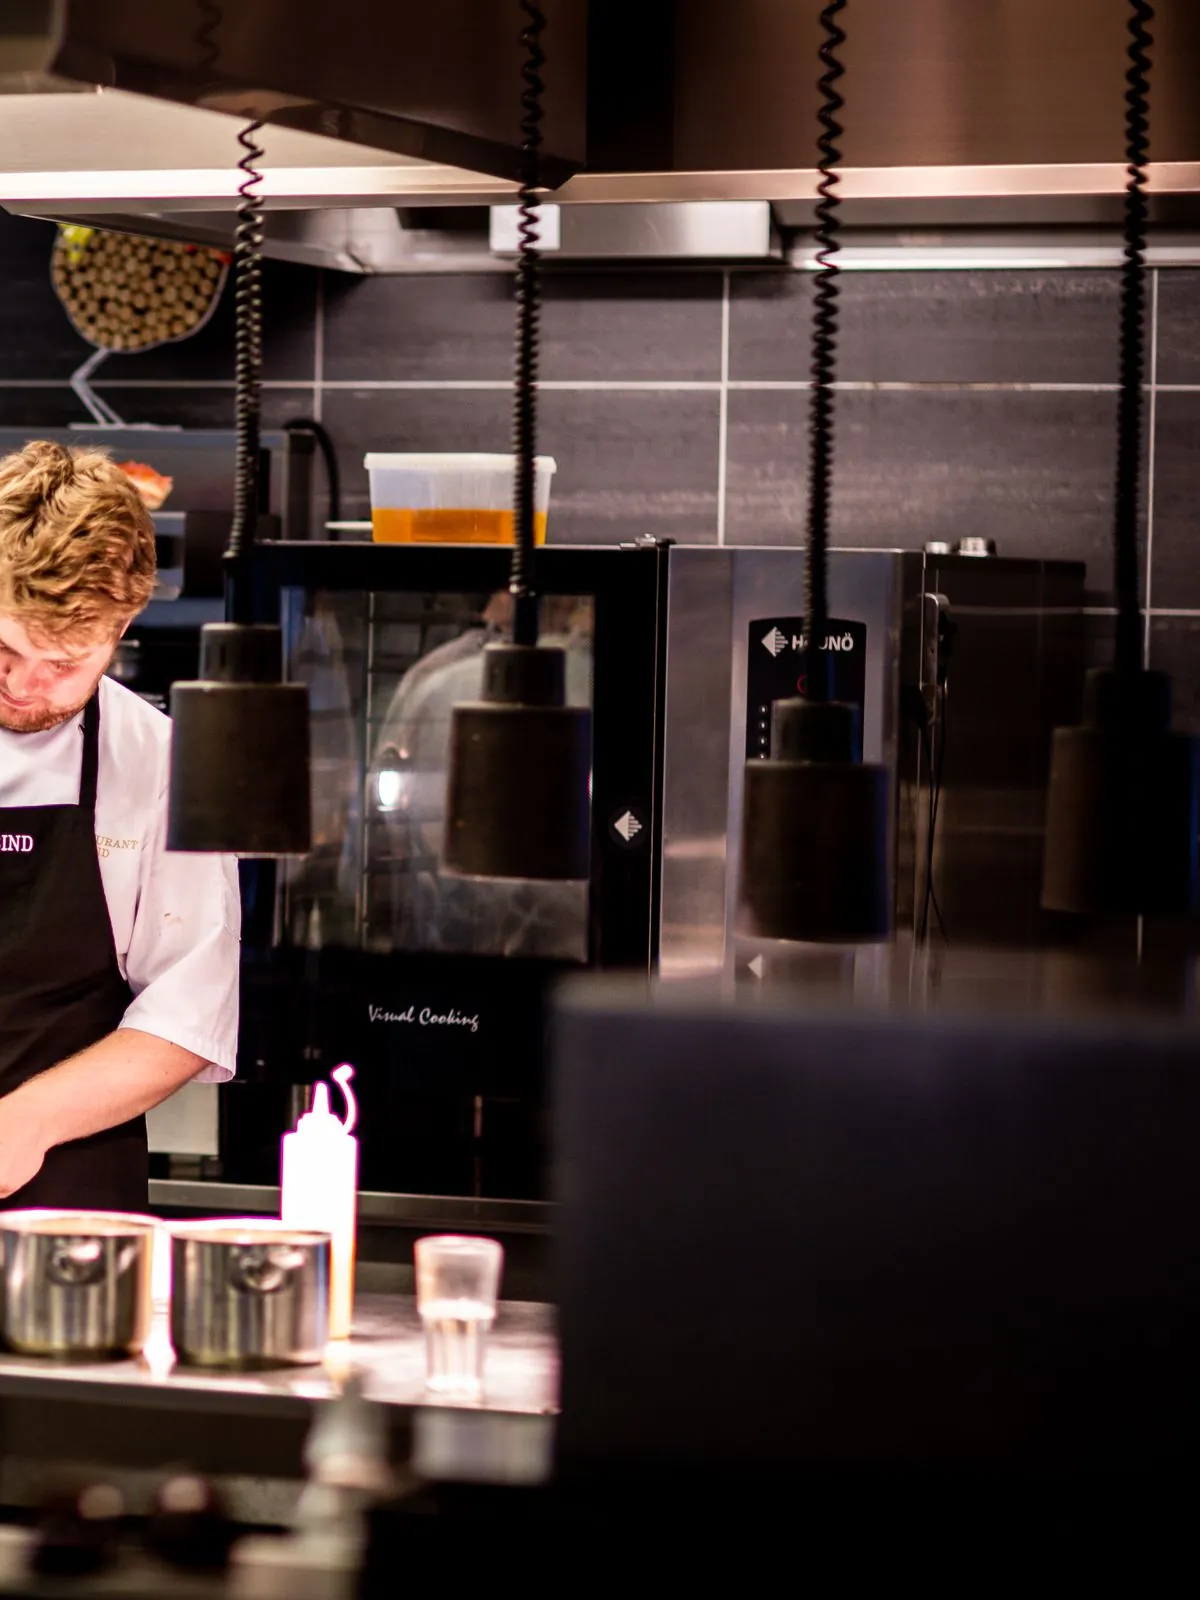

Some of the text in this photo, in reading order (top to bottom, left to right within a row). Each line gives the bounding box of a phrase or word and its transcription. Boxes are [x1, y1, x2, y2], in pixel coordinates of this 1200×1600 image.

[792, 632, 854, 651] HUNÖ
[368, 1004, 479, 1032] Visual Cooking
